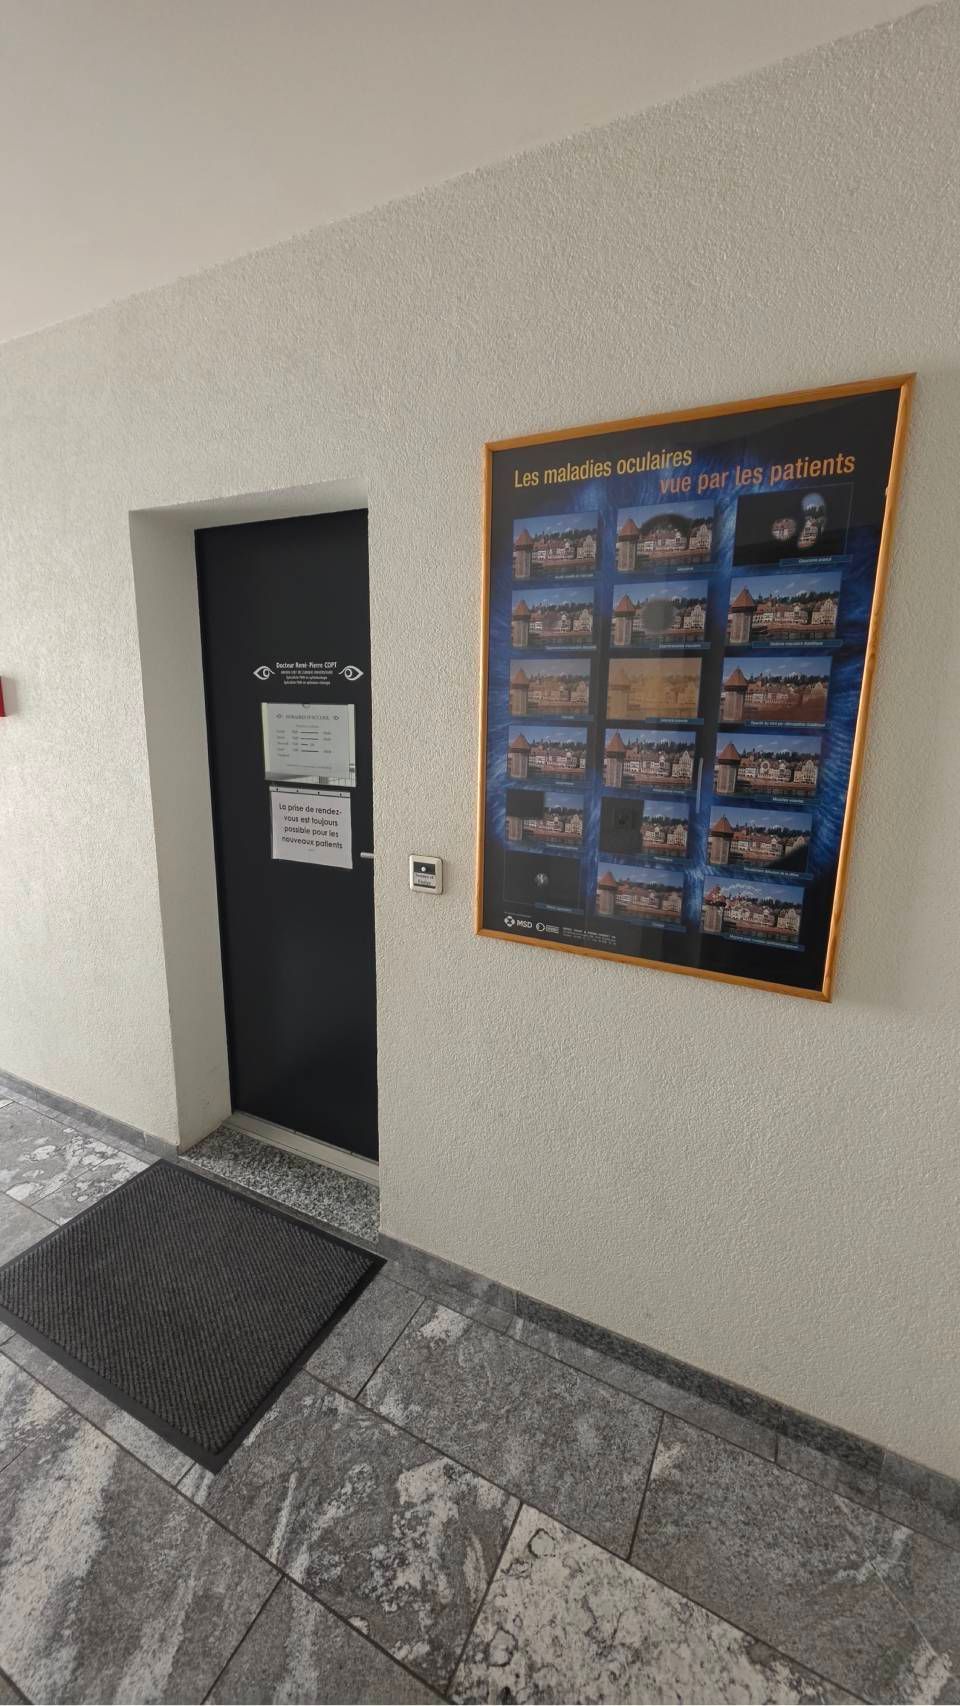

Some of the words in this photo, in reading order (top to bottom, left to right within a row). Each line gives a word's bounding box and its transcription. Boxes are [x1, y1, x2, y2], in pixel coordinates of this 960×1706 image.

[514, 469, 539, 488] Les
[544, 459, 612, 485] maladies
[617, 449, 693, 475] oculaires
[660, 475, 692, 495] vue
[697, 471, 729, 494] par
[735, 465, 763, 486] les
[770, 453, 856, 486] patients
[288, 804, 304, 812] prise
[305, 805, 314, 813] de
[315, 807, 342, 815] rendez-
[312, 817, 338, 827] toujours
[284, 826, 311, 834] possible
[328, 829, 339, 838] les
[282, 836, 314, 846] nouveaux
[315, 840, 343, 849] patients
[516, 919, 533, 929] MSD
